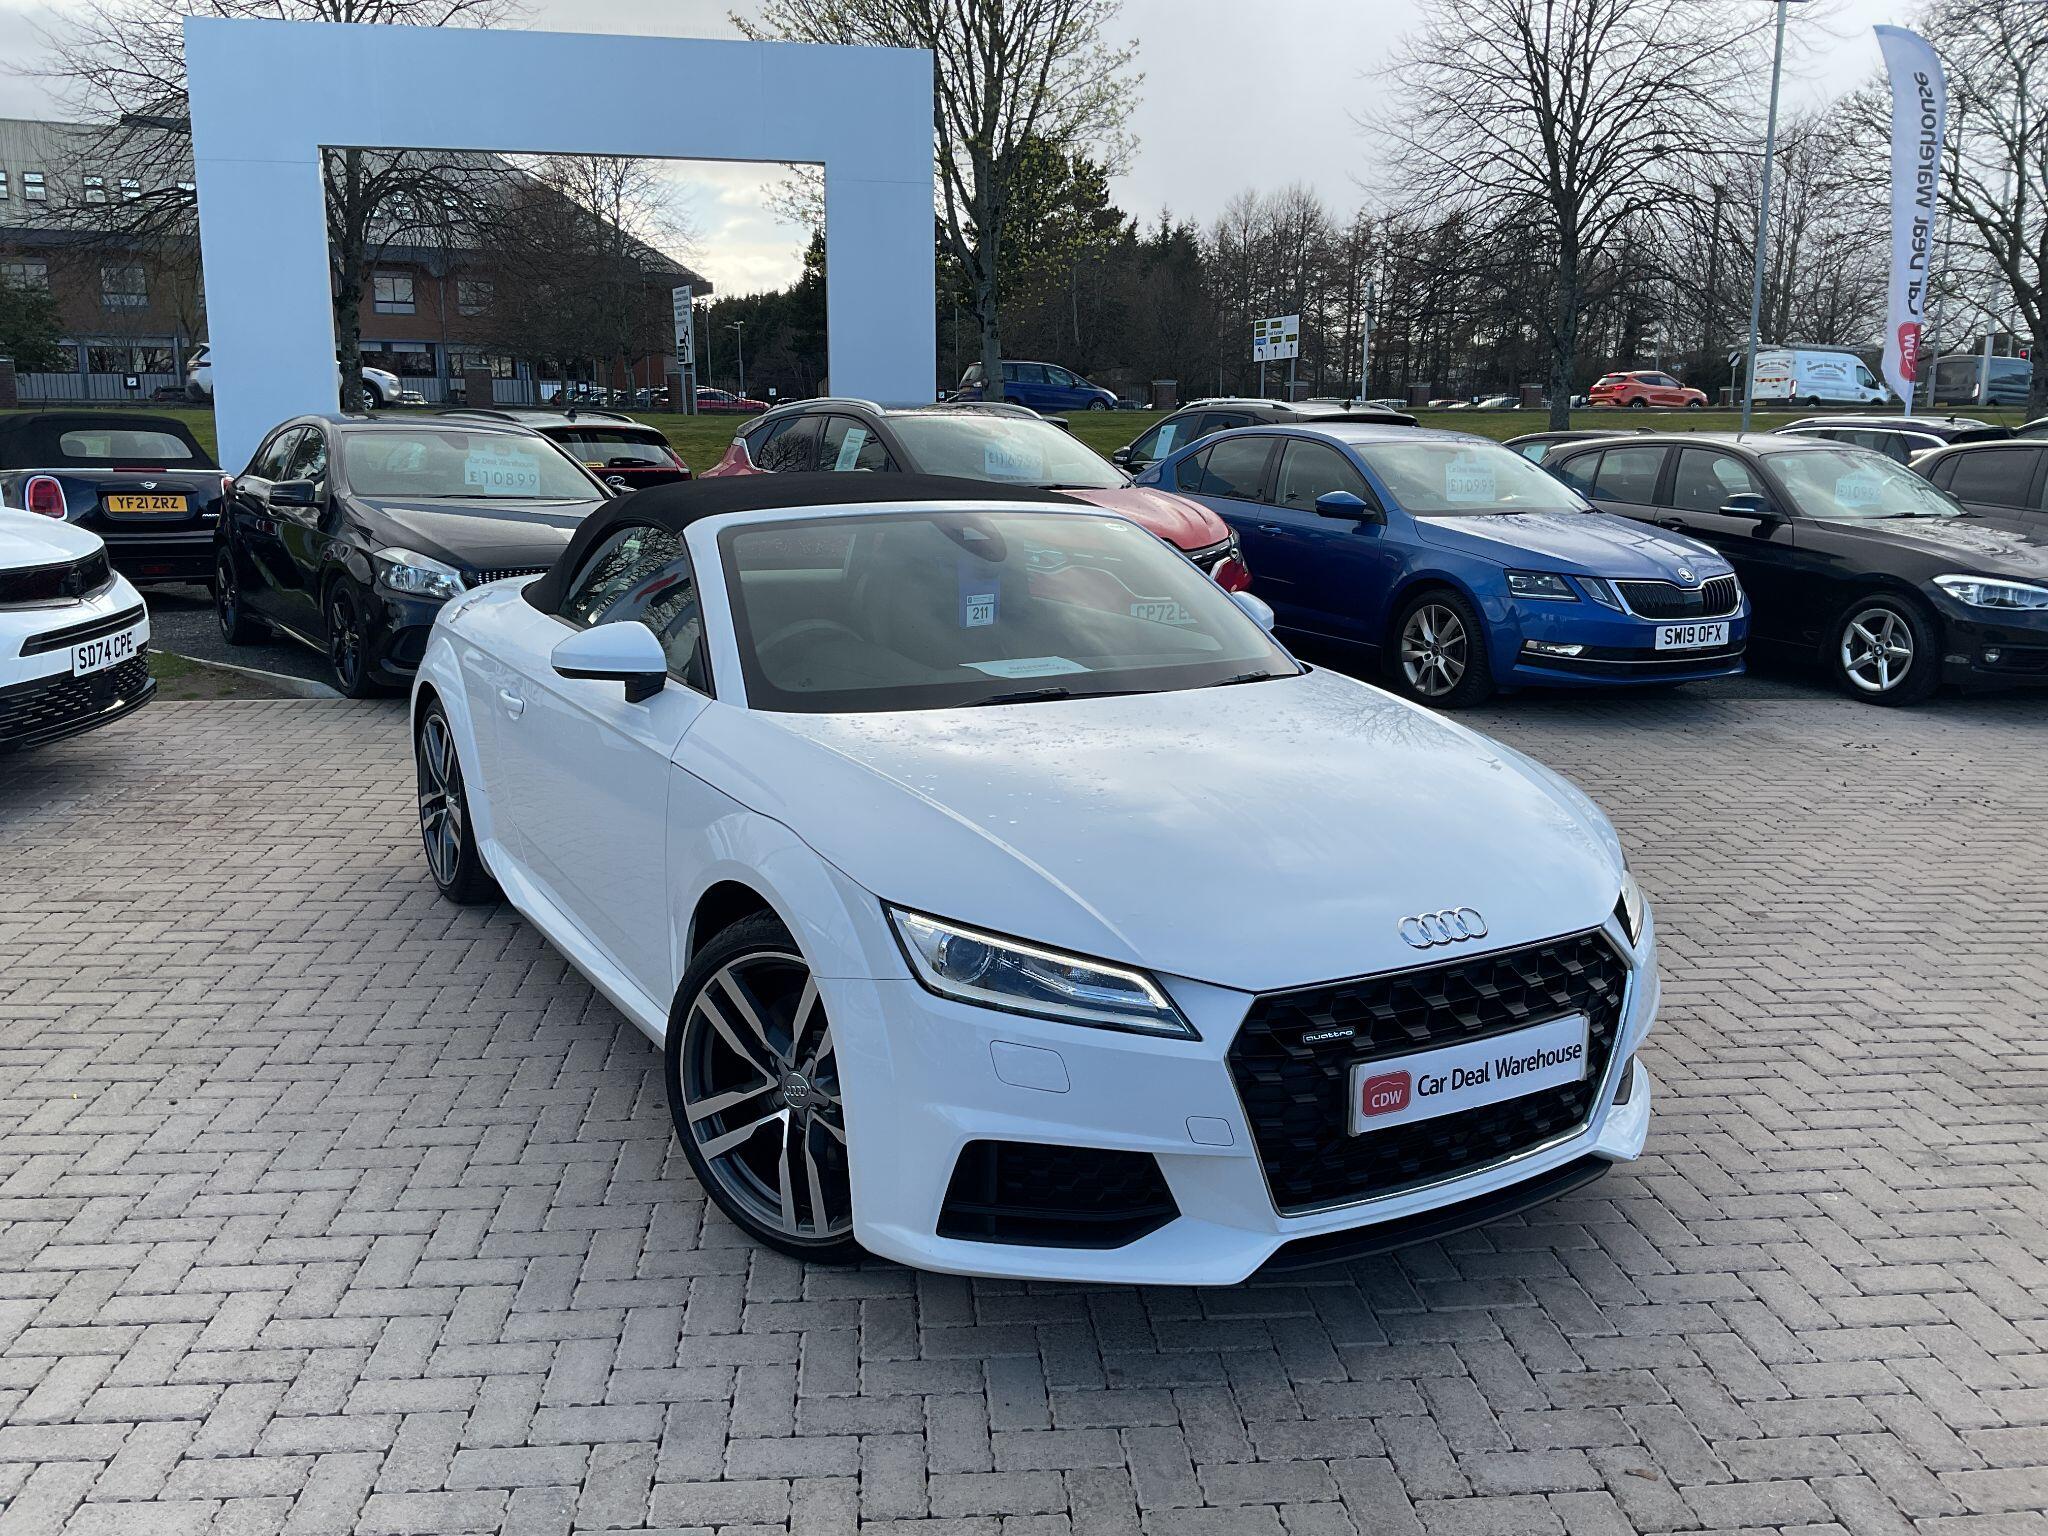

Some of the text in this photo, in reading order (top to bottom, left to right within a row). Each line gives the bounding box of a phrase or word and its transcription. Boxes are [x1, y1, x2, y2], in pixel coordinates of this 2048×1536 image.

[469, 470, 537, 488] £10899
[117, 496, 179, 509] YF21 ZRZ
[972, 606, 988, 620] 211
[1664, 624, 1722, 645] SW19 OFX
[79, 631, 133, 669] SD74 CPE
[1305, 1030, 1353, 1042] quattro
[1417, 1043, 1582, 1097] Car Deal Warehouse
[1371, 1089, 1403, 1109] CDW
